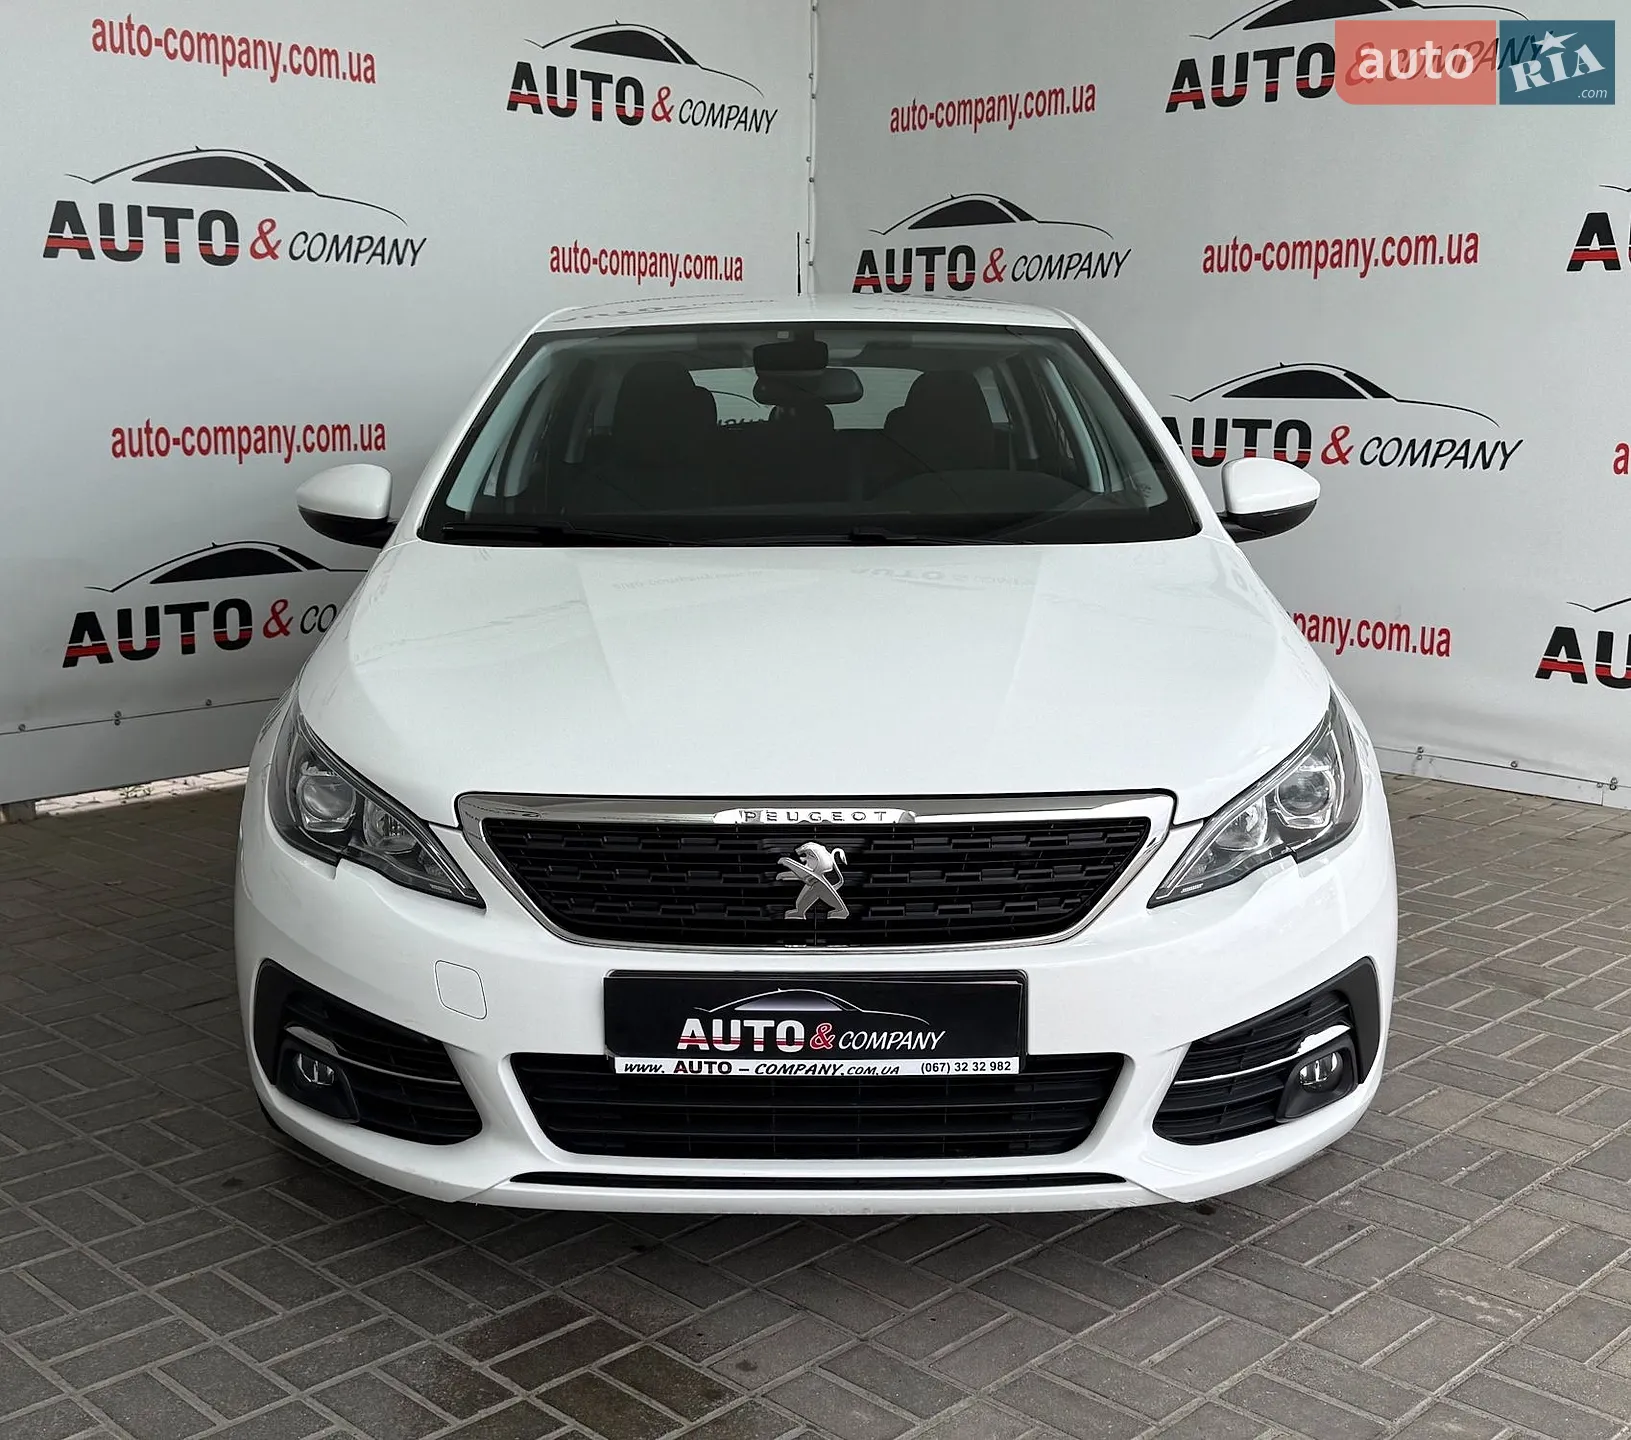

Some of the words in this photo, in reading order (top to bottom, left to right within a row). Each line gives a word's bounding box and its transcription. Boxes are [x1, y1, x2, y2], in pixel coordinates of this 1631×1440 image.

[92, 14, 375, 83] auto-company.com.ua
[507, 61, 644, 126] AUTO
[652, 87, 674, 123] &
[679, 99, 778, 134] COMPANY
[1166, 42, 1336, 113] AUTO
[891, 84, 1095, 133] auto-company.com.ua
[43, 201, 239, 266] AUTO
[250, 219, 281, 260] &
[289, 231, 427, 266] COMPANY
[1203, 233, 1478, 279] auto-company.com.ua
[1567, 212, 1631, 272] A
[550, 240, 743, 287] auto-company.com.ua
[853, 245, 976, 293] AUTO
[982, 248, 1004, 283] &
[1012, 249, 1131, 282] COMPANY
[112, 419, 385, 464] auto-company.com.ua
[1321, 426, 1354, 465] &
[1360, 437, 1523, 471] COMPANY
[62, 597, 253, 668] AUTO
[263, 599, 293, 638] &
[744, 810, 887, 822] PEUGEOT
[677, 1018, 805, 1053] AUTO
[809, 1022, 836, 1051] &
[838, 1030, 946, 1051] COMPANY
[673, 1061, 733, 1075] AUTO
[921, 1062, 950, 1074] (067)
[954, 1062, 969, 1073] 32
[972, 1062, 987, 1073] 32
[990, 1061, 1012, 1072] 982
